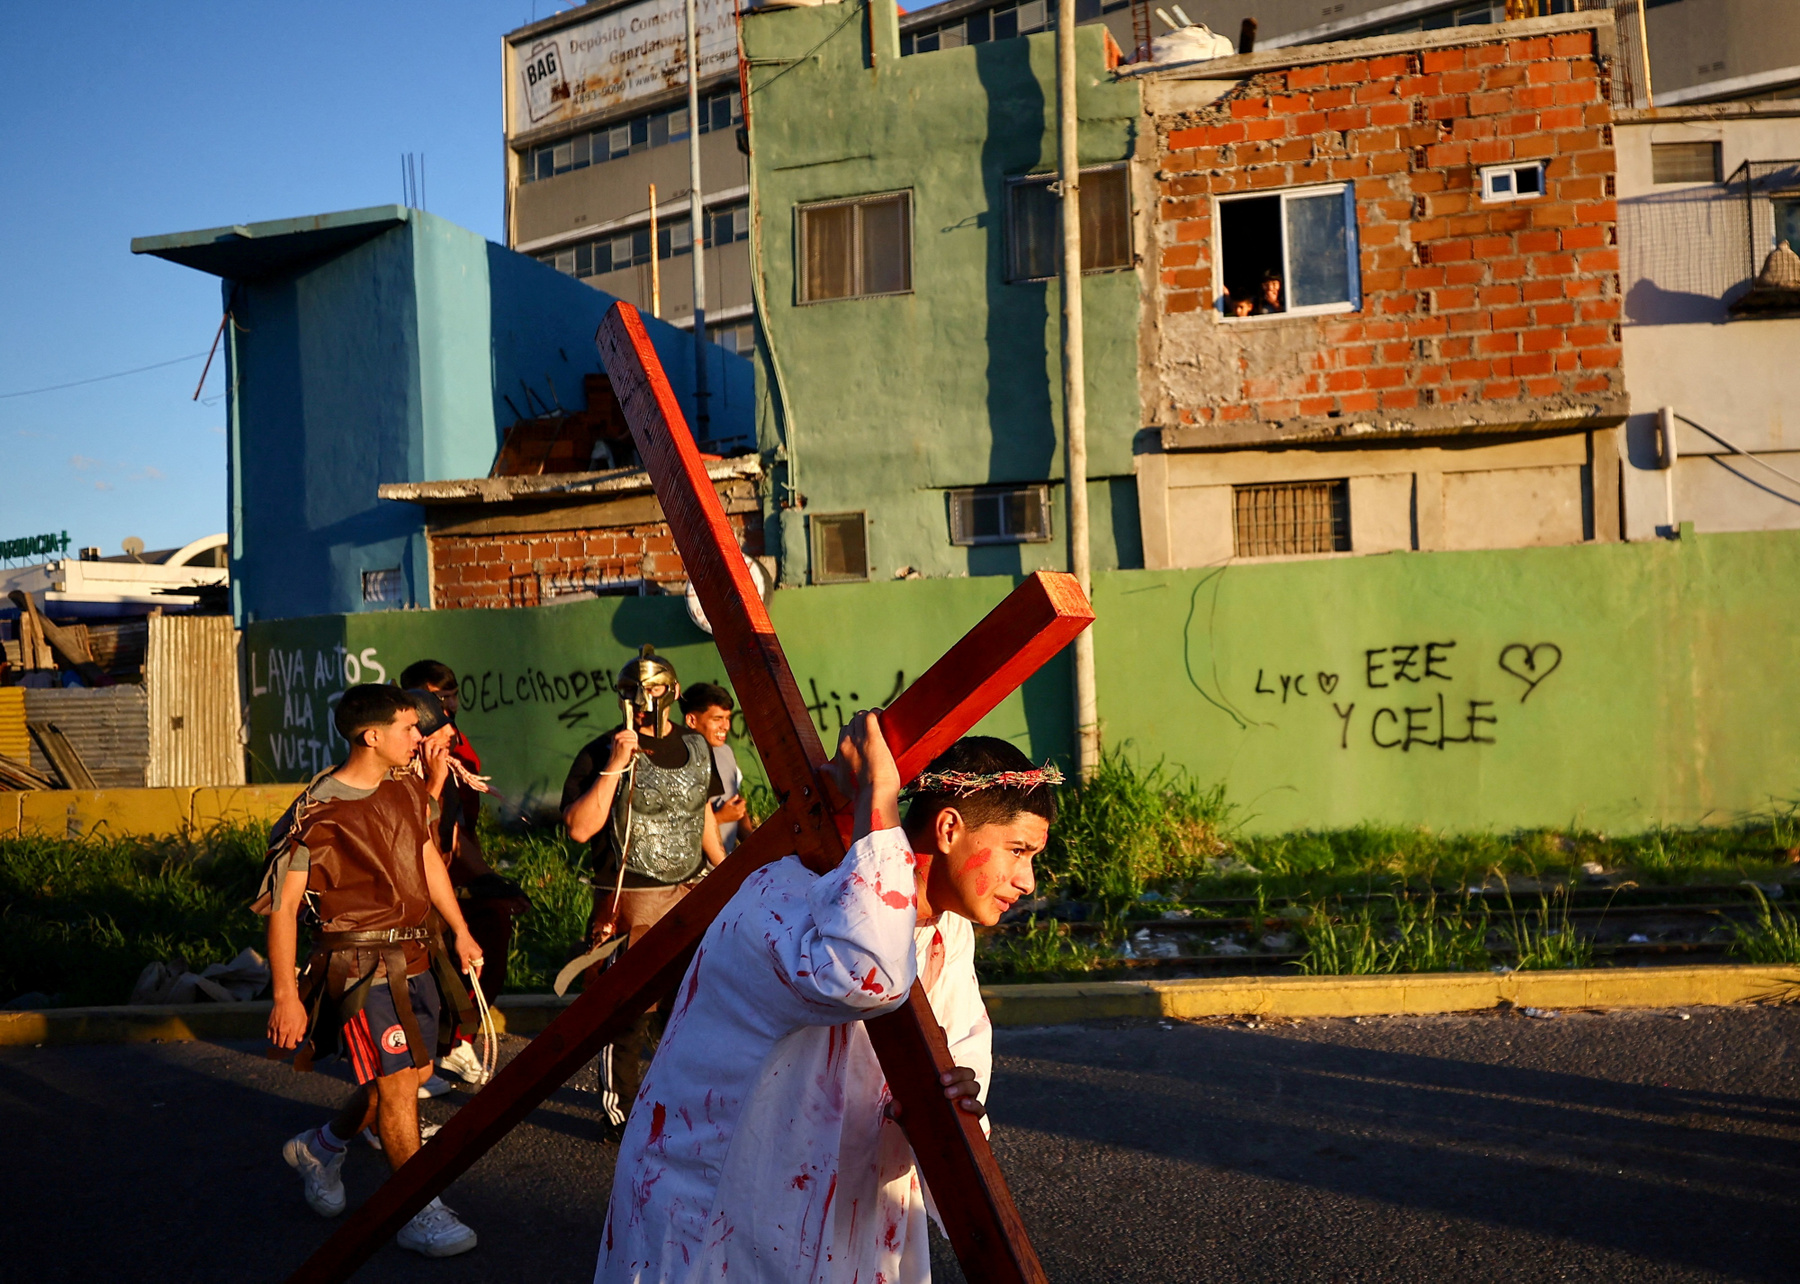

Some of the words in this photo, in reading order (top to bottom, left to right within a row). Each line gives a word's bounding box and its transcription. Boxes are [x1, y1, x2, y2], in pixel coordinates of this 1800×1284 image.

[527, 52, 557, 86] BAG
[252, 648, 306, 697] LAVA
[314, 641, 386, 690] AUTOS
[1365, 641, 1457, 688] EZE
[1333, 703, 1354, 749] Y
[1372, 693, 1498, 752] CELE
